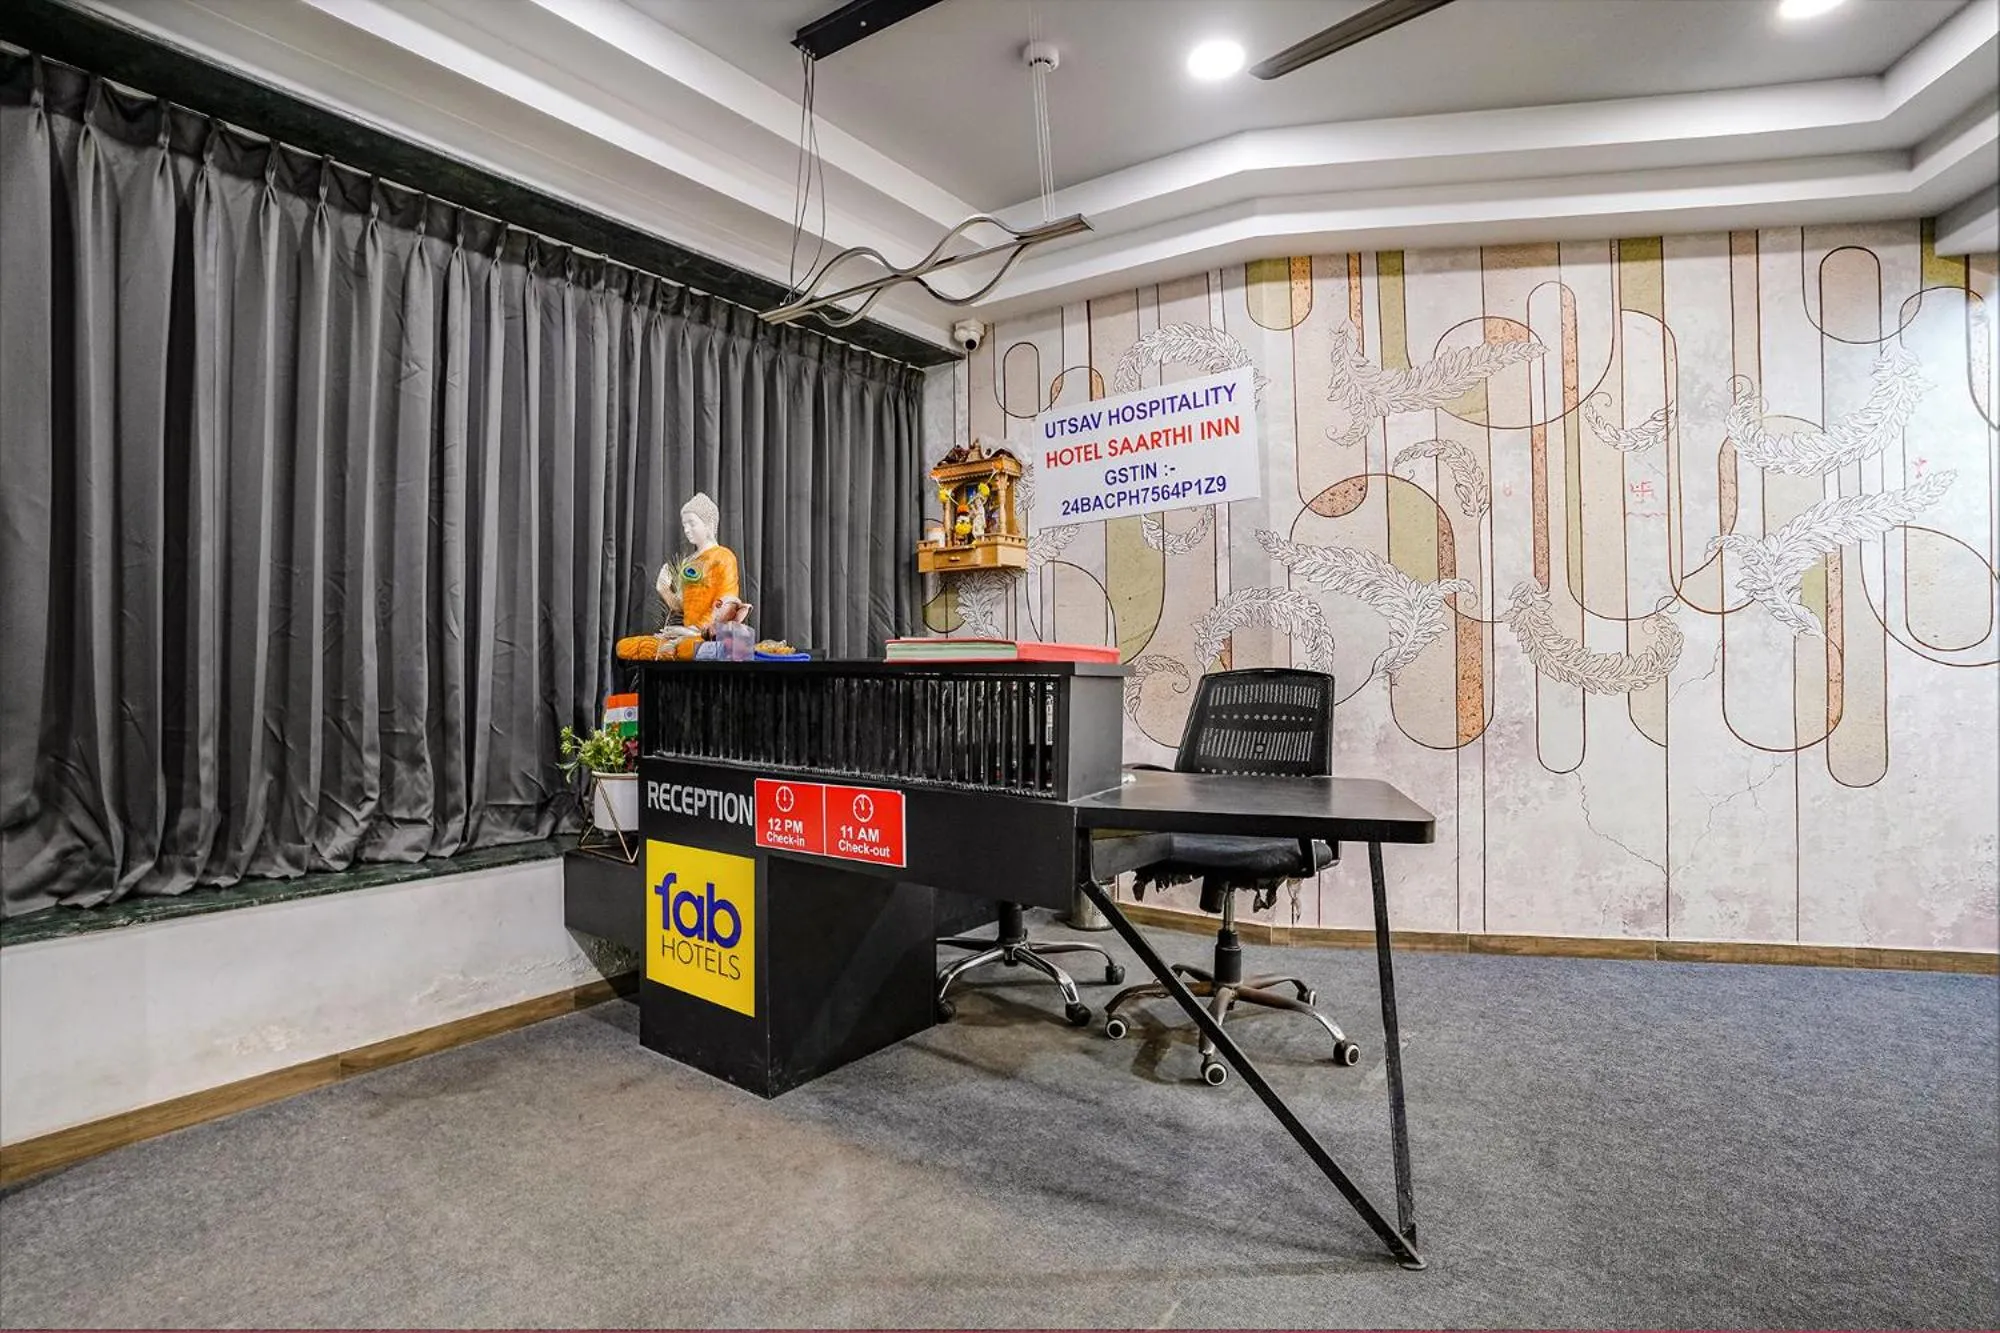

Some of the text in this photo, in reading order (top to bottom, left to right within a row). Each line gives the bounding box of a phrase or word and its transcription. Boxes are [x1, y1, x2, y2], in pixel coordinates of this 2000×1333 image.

[1044, 382, 1237, 438] UTSAV HOSPITALITY
[1046, 415, 1240, 469] HOTEL SAARTHI INN
[1104, 461, 1157, 486] GSTIN
[1061, 475, 1227, 517] 24BACPH7564P1Z9
[647, 780, 753, 827] RECEPTION
[766, 831, 805, 847] Check-in
[767, 817, 803, 834] 12 PM
[840, 825, 880, 843] 11 AM
[838, 839, 890, 858] Check-out
[654, 872, 742, 949] fab
[661, 934, 741, 981] HOTELS
